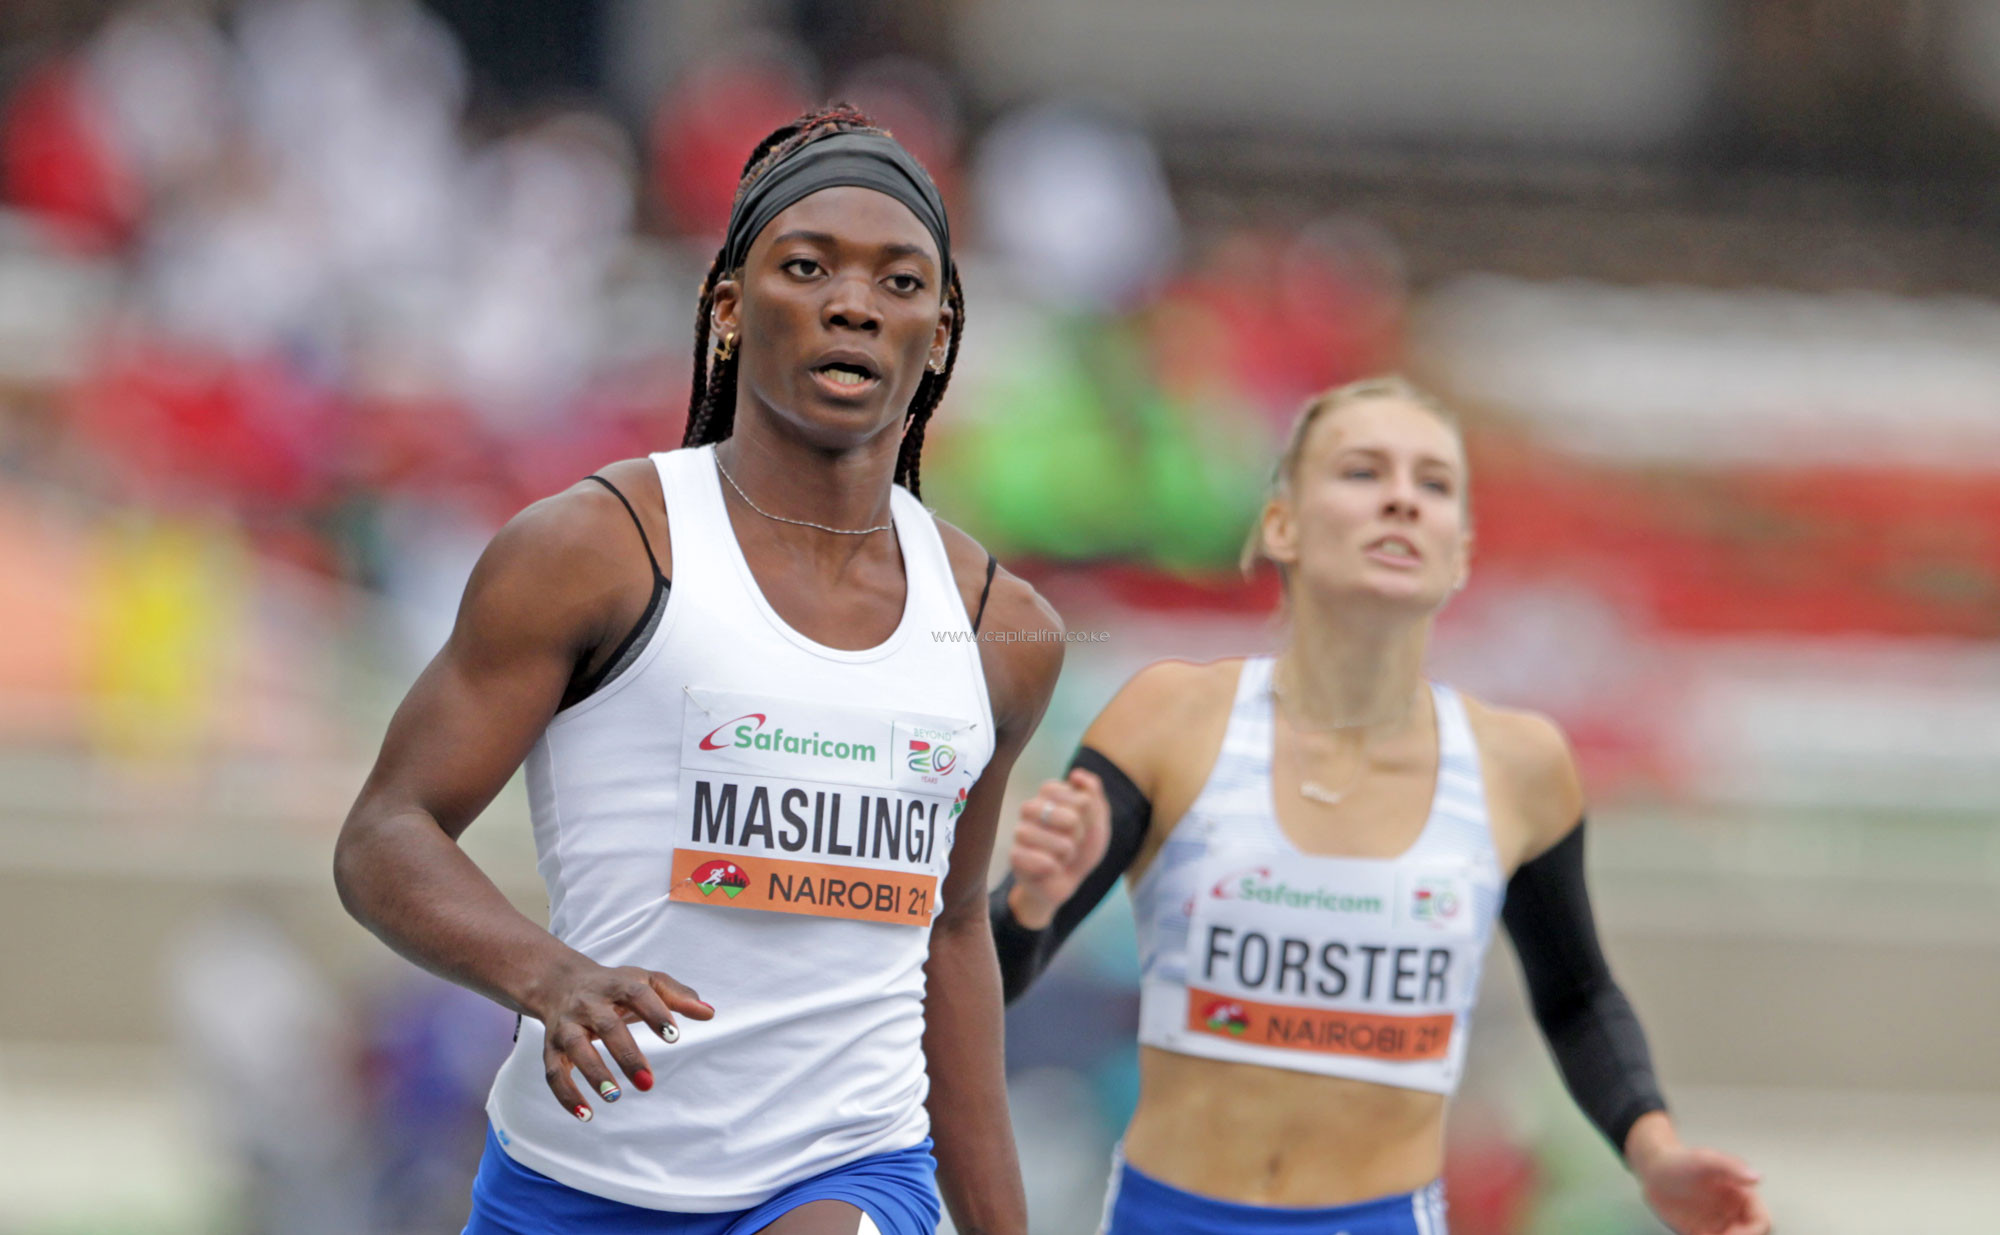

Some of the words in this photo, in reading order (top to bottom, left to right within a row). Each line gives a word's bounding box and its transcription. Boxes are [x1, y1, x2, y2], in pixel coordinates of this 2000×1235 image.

[733, 724, 876, 763] Safaricom
[913, 728, 952, 742] BEYOND
[920, 776, 939, 784] YEARS
[691, 779, 939, 864] MASILINGI
[768, 872, 901, 914] NAIROBI
[1238, 877, 1383, 914] Safaricom
[1202, 924, 1453, 1004] FORSTER
[1266, 1015, 1407, 1054] NAIROBI
